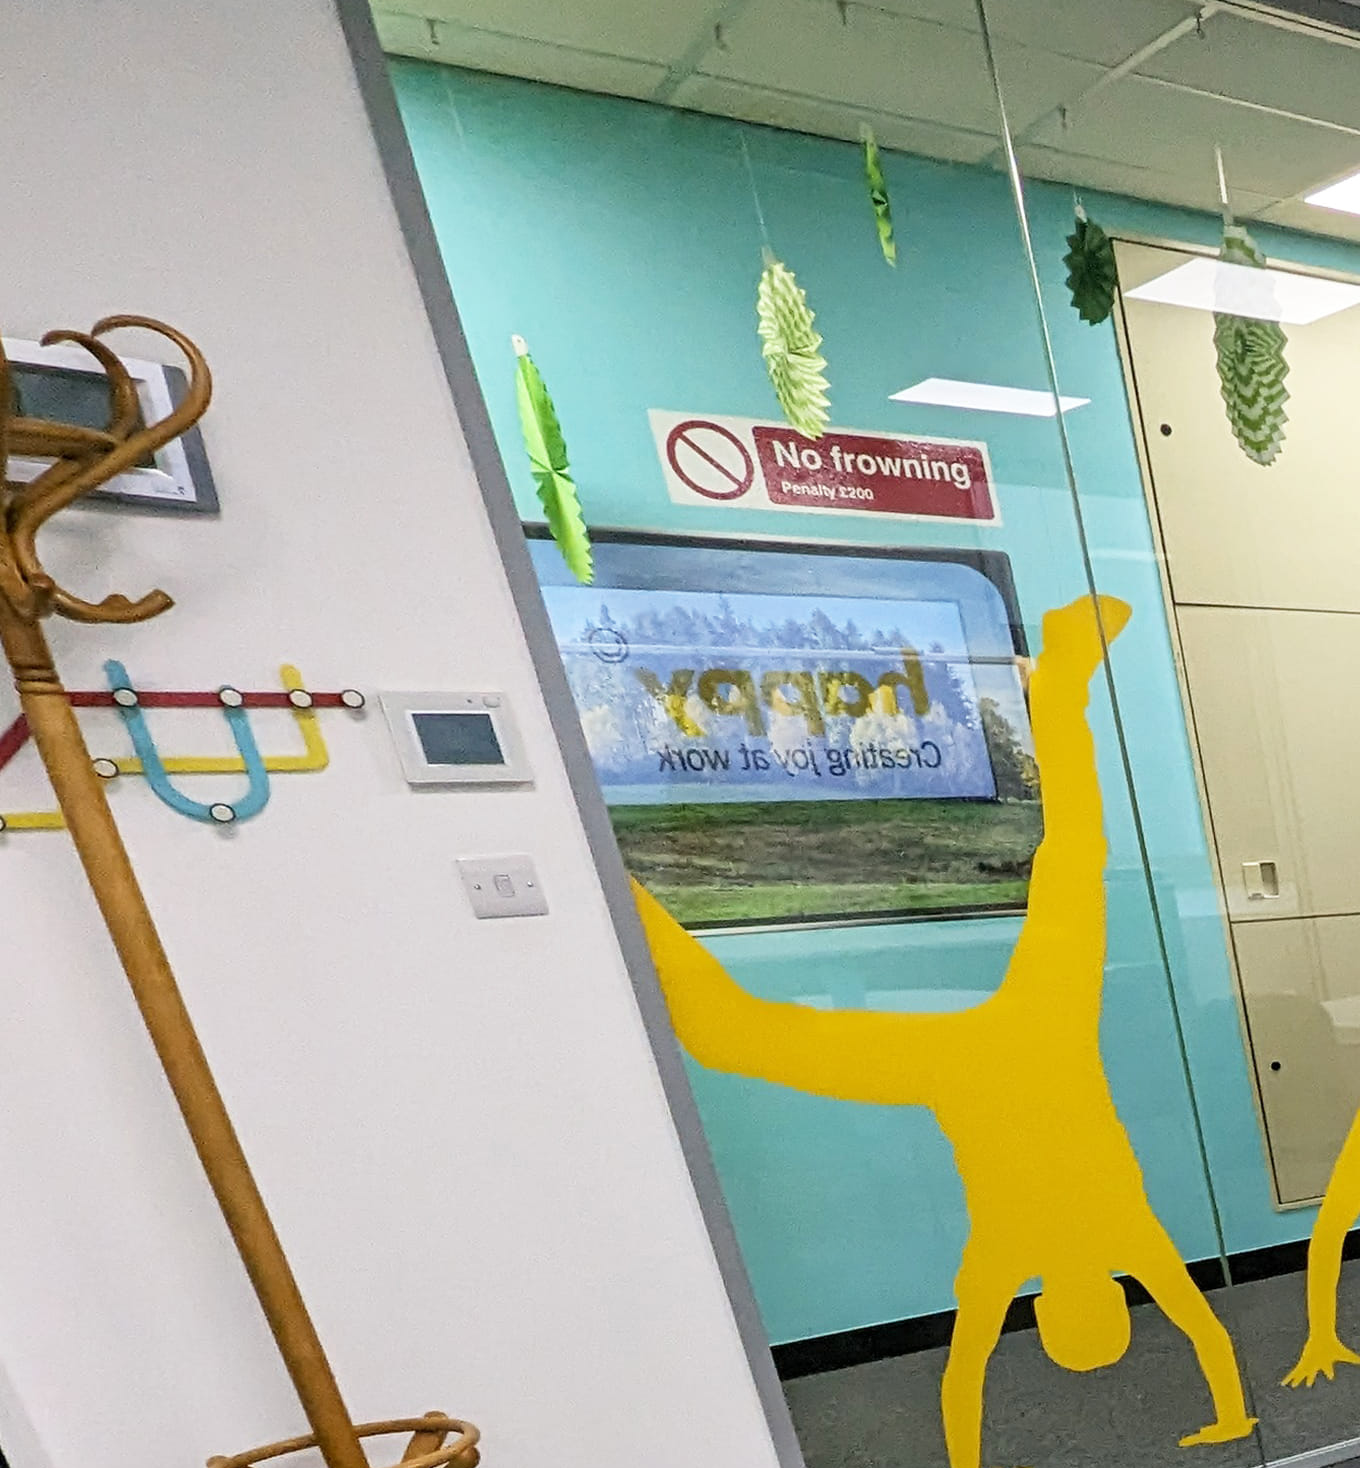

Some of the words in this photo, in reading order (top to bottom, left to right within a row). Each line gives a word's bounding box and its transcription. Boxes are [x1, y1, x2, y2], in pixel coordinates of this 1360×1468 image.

[772, 440, 822, 470] No
[830, 446, 971, 489] frowning
[781, 481, 836, 500] Penalty
[839, 486, 874, 500] £200
